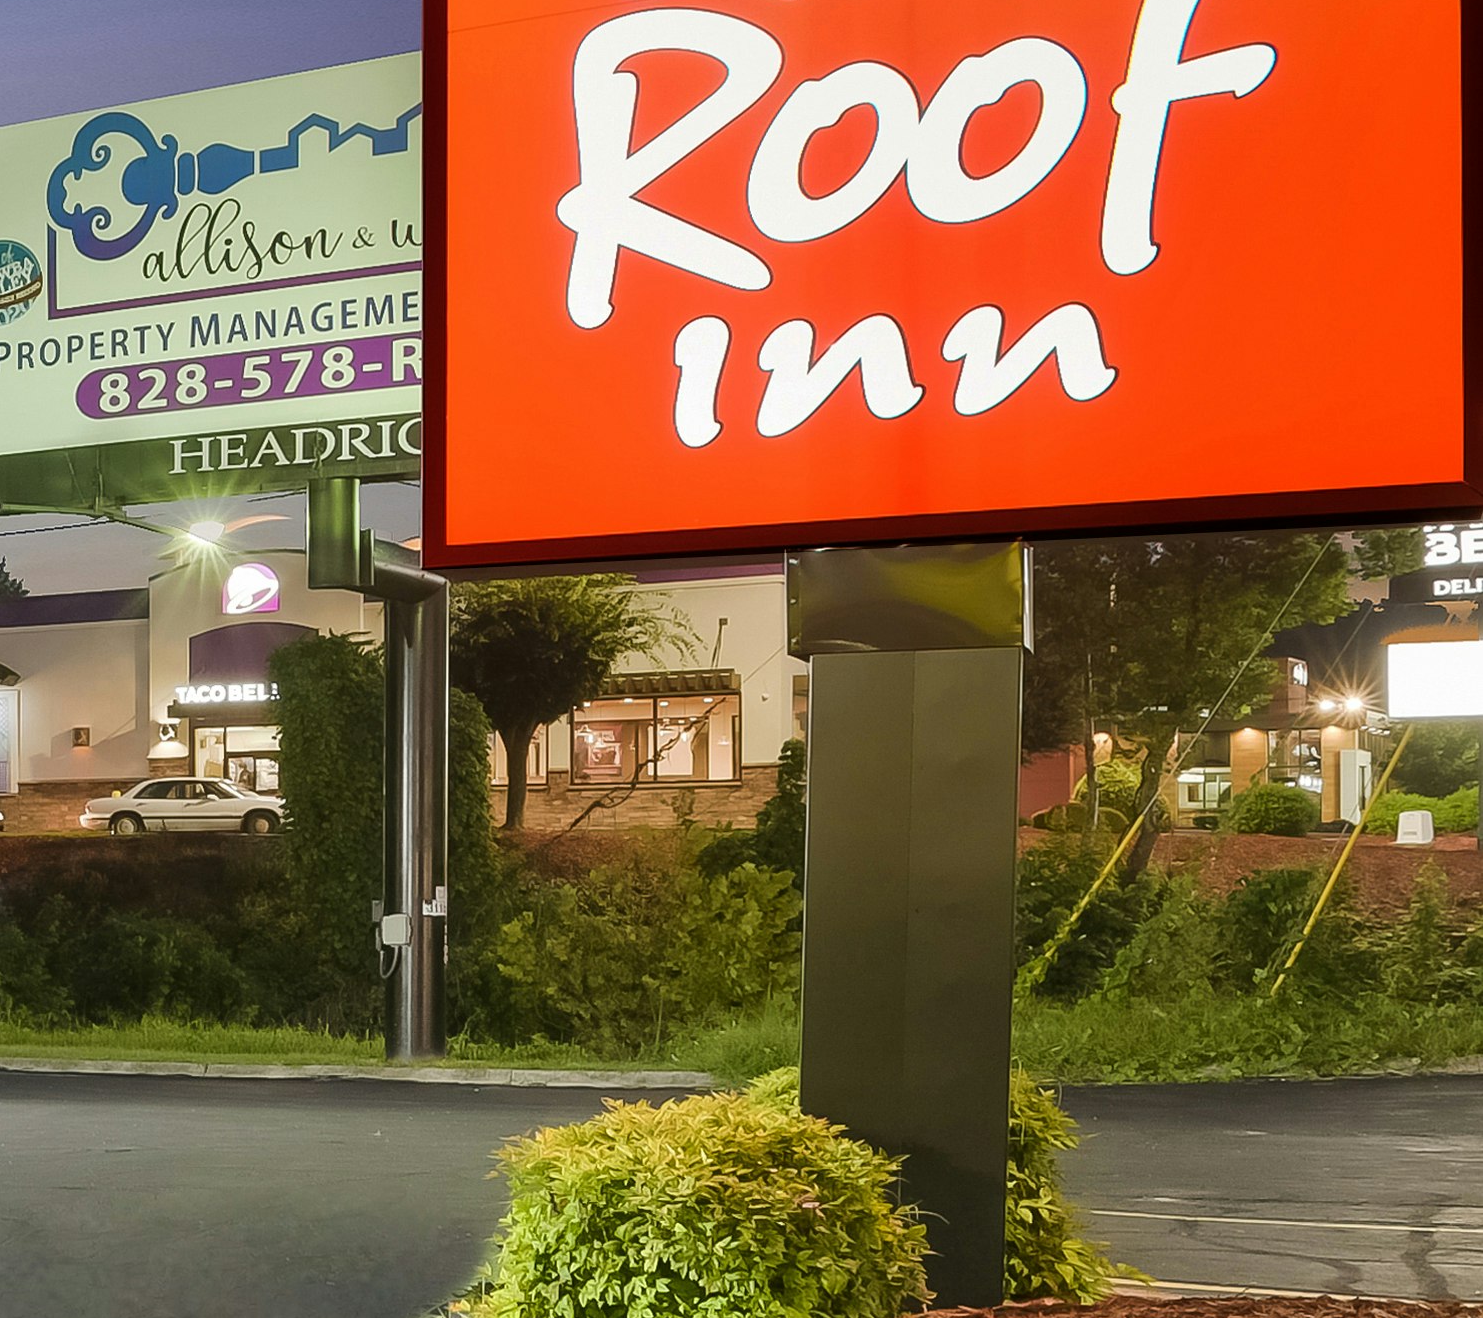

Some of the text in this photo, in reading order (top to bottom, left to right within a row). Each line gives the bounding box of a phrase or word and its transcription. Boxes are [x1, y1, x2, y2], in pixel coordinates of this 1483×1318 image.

[143, 198, 343, 281] allison
[352, 226, 375, 249] &
[175, 684, 226, 704] TACO
